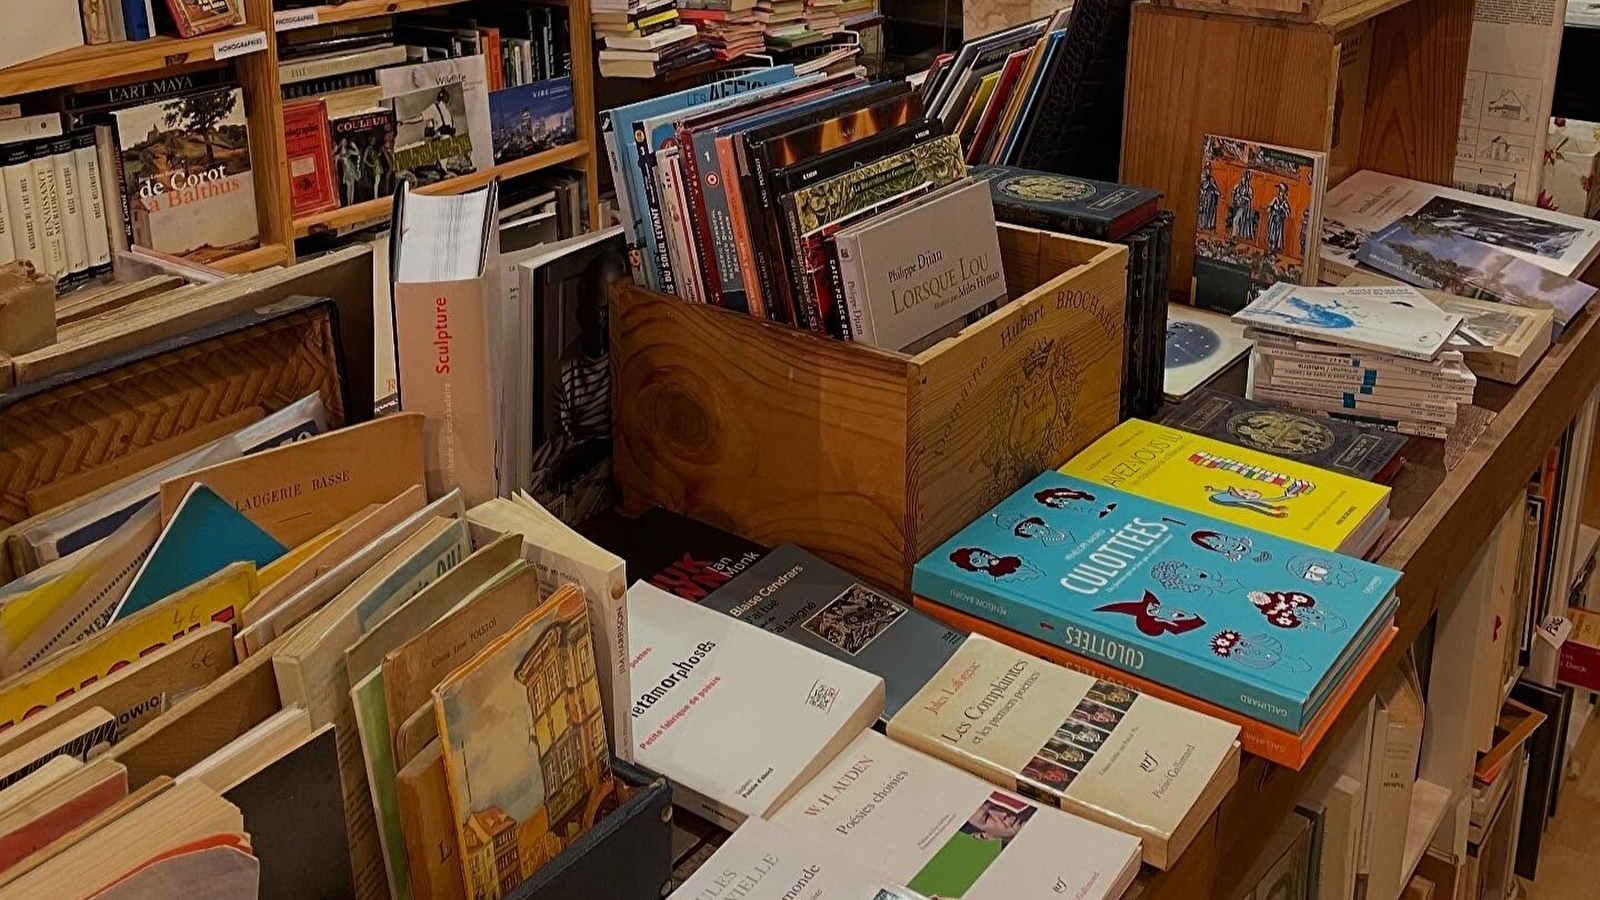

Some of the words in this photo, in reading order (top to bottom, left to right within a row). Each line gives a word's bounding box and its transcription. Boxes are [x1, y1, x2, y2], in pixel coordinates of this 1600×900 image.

[276, 14, 314, 26] PHOTOGRAPHIE
[218, 38, 262, 53] MONOGRAPHIES
[109, 83, 148, 103] L'ART
[153, 76, 193, 94] MAYA
[337, 115, 388, 132] COULEUR
[139, 180, 164, 200] de
[170, 164, 227, 191] Corot
[168, 177, 240, 210] Balthus
[37, 169, 52, 238] RENAISSANCE
[649, 205, 664, 239] LEVANT
[656, 240, 670, 268] SOLEIL
[888, 263, 917, 284] Philippe
[916, 249, 944, 271] Djian
[890, 270, 958, 316] LORSQUE
[958, 253, 989, 280] LOU
[957, 281, 977, 297] Miles
[976, 270, 1000, 291] Hyman
[433, 297, 453, 375] Sculpture
[1000, 303, 1046, 350] Hubert
[1056, 290, 1117, 342] BROCHARD
[1101, 437, 1168, 488] AVEZ-VOUS
[233, 483, 302, 511] LAUGERIE
[311, 470, 351, 492] BASSE
[706, 556, 732, 573] Ian
[718, 551, 761, 579] Monk
[1060, 516, 1170, 595] CULOTTÉES
[1162, 517, 1187, 526] 1
[728, 591, 761, 618] Blaise
[758, 564, 804, 598] Cendrars
[762, 599, 780, 615] tué
[787, 600, 816, 623] saigné
[616, 605, 625, 657] HARRISON
[1065, 625, 1145, 670] CULOTTÉES
[618, 657, 626, 675] JIM
[924, 693, 945, 717] Jules
[941, 660, 982, 695] Laforgue
[941, 718, 970, 745] Les
[969, 658, 1030, 723] Complaintes
[1240, 693, 1288, 718] GALLIMARD
[639, 729, 663, 751] Petite
[660, 702, 691, 733] fabrique
[689, 694, 700, 705] de
[971, 733, 983, 746] et
[979, 720, 992, 736] les
[988, 696, 1019, 730] premiers
[1138, 749, 1160, 775] nrf
[804, 802, 821, 819] W.
[819, 787, 838, 808] H.
[833, 754, 876, 794] AUDEN
[836, 799, 876, 837] Poésies
[871, 768, 910, 806] choisies
